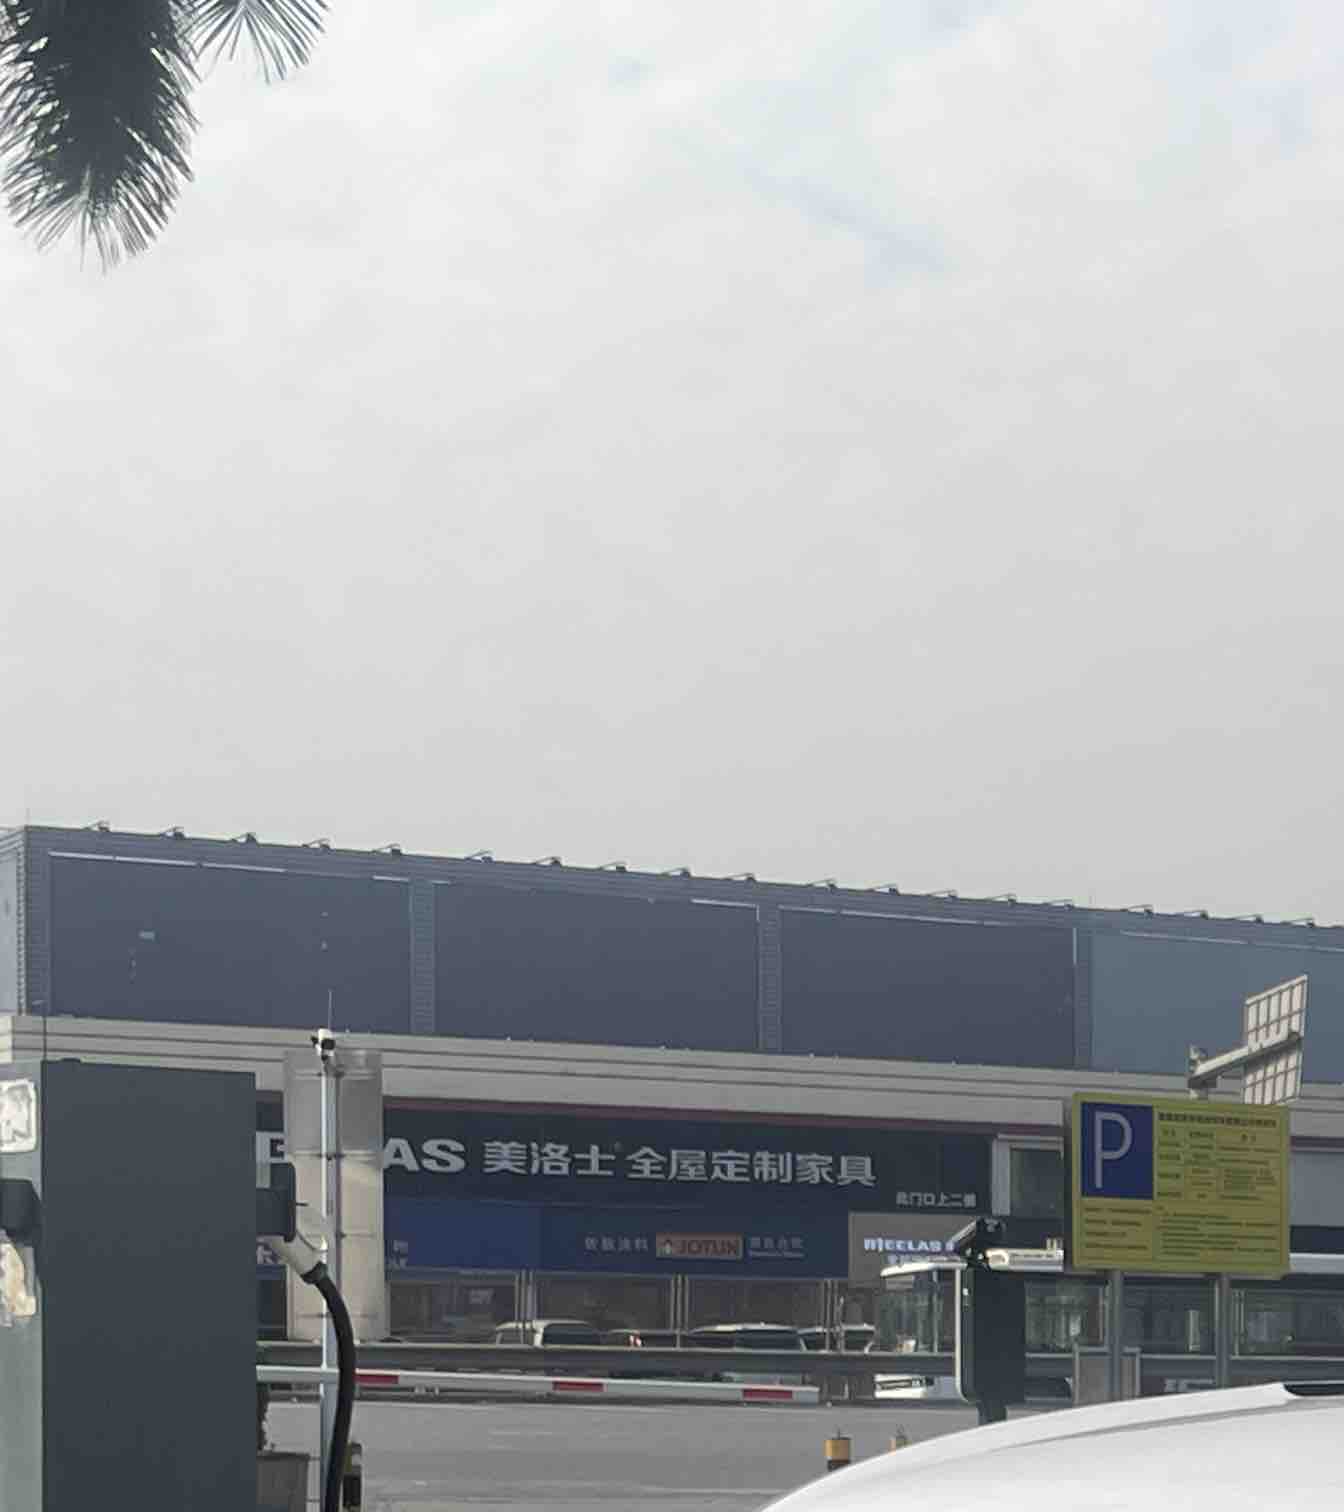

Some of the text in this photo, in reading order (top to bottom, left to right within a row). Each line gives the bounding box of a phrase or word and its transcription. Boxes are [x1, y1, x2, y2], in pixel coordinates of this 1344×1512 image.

[482, 1141, 615, 1177] 美洛士
[626, 1146, 877, 1188] 全屋定制家具
[1094, 1111, 1133, 1189] P
